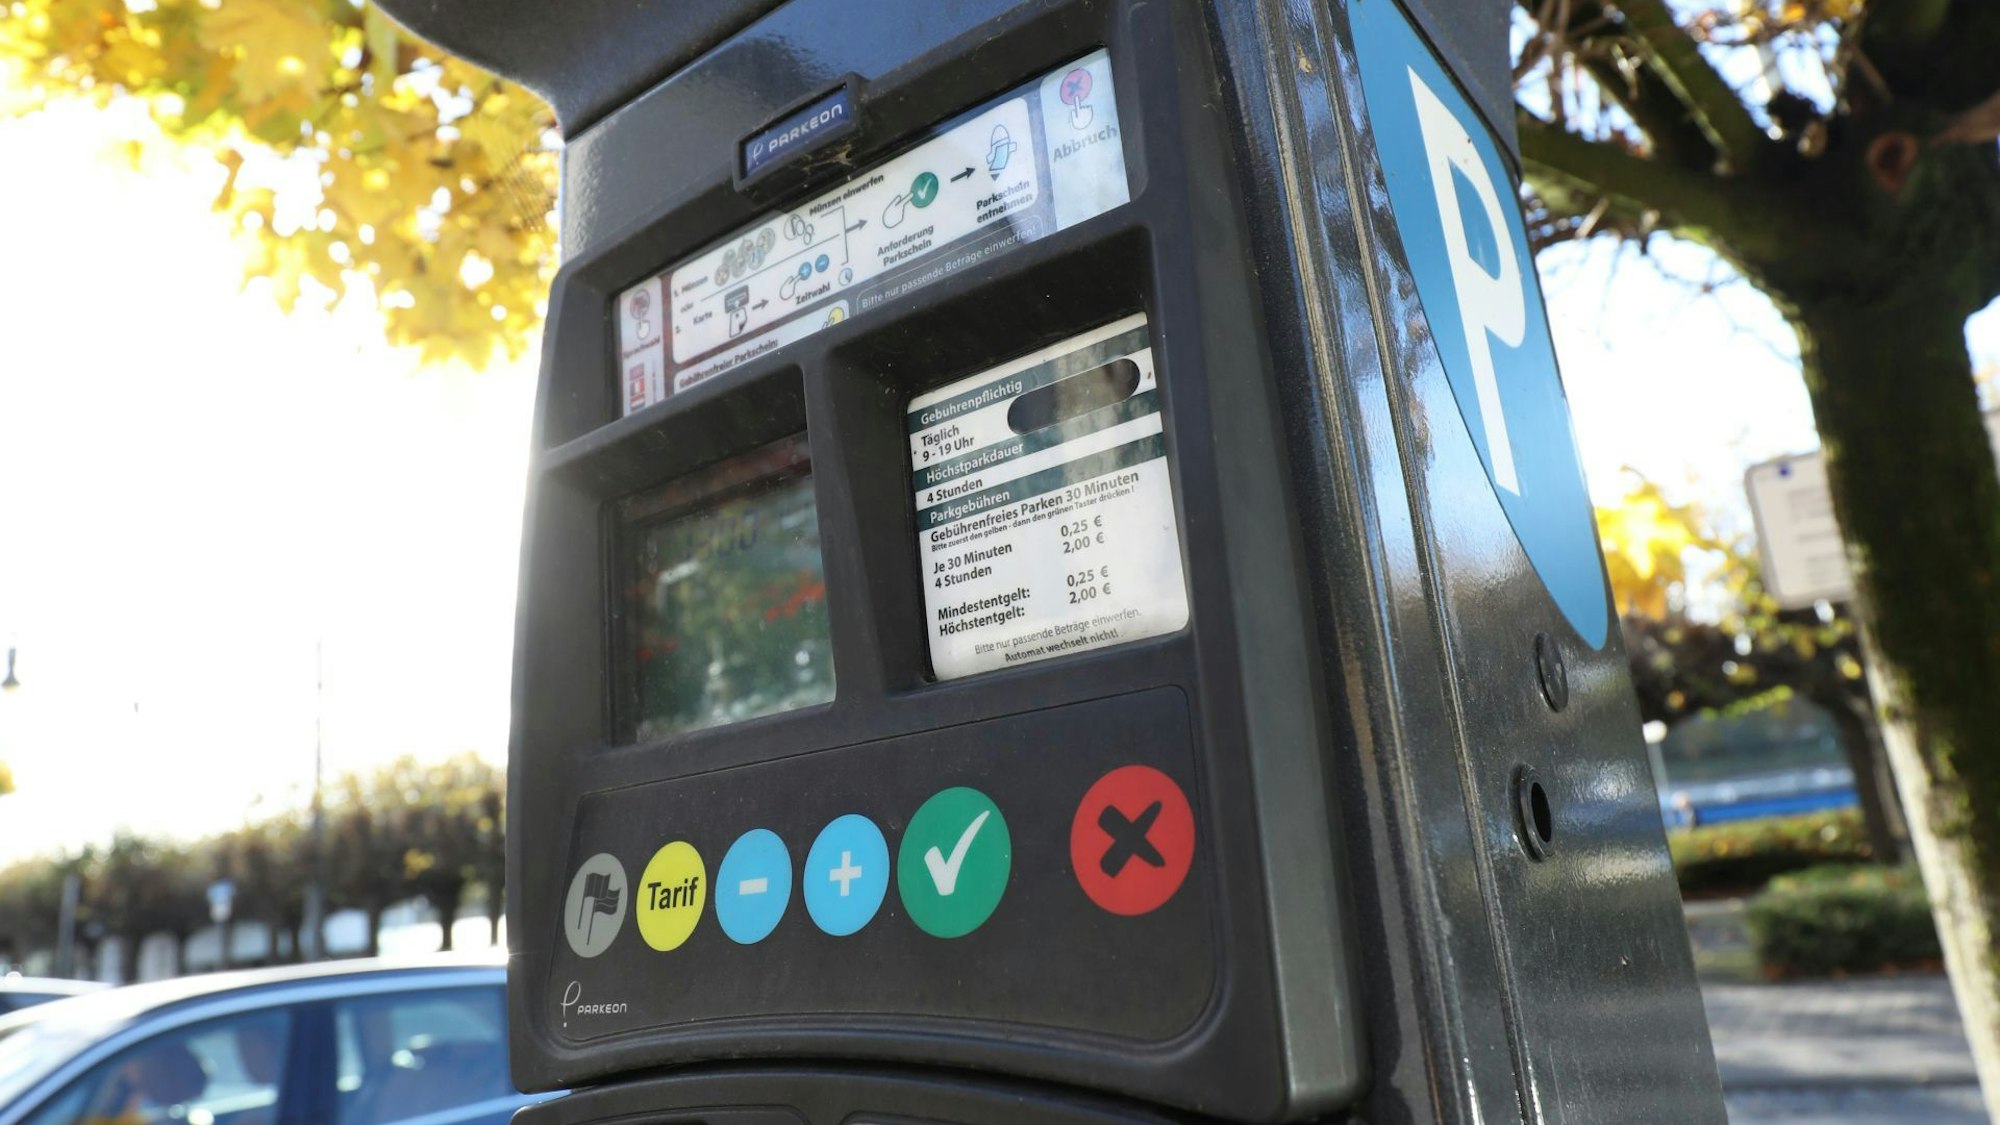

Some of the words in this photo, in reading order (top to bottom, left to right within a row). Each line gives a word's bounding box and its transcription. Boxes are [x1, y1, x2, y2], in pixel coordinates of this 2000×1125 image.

[767, 103, 843, 153] PARKEON
[1053, 124, 1118, 163] Abbruch
[842, 173, 884, 200] einwerfen
[976, 179, 1030, 211] Parkschein
[976, 193, 1033, 223] entnehmen
[878, 225, 934, 257] Anforderung
[883, 239, 932, 267] Parkschein
[862, 293, 882, 308] Bitte
[884, 287, 900, 299] nur
[901, 267, 944, 294] passende
[945, 250, 983, 273] Beträge
[984, 226, 1037, 255] einwerfen!
[1406, 64, 1526, 497] P
[795, 282, 831, 305] Zeitwahl
[693, 311, 713, 325] Karte
[734, 339, 778, 364] Parkschein:
[921, 425, 960, 447] Täglich
[922, 450, 930, 462] 9
[938, 443, 952, 457] 19
[954, 436, 974, 451] Uhr
[926, 443, 1024, 484] Höchstparkdauer
[926, 493, 934, 504] 4
[936, 477, 983, 501] Stunden
[930, 508, 1018, 542] Gebührenfreies
[1021, 494, 1063, 516] Parken
[1065, 487, 1081, 502] 30
[1084, 472, 1139, 496] Minuten
[930, 491, 1011, 524] Parkgebühren
[931, 542, 947, 552] Bitte
[948, 536, 968, 547] zuerst
[970, 531, 983, 541] den
[983, 524, 1008, 538] gelben
[1013, 518, 1031, 528] dann
[1032, 512, 1046, 522] den
[1047, 504, 1074, 519] grünen
[1075, 497, 1097, 510] Taster
[1099, 488, 1130, 502] drücken
[933, 562, 946, 575] Je
[947, 556, 961, 570] 30
[964, 543, 1013, 565] Minuten
[1060, 519, 1088, 537] 0,25
[1093, 514, 1103, 527] €
[935, 578, 942, 589] 4
[944, 564, 992, 588] Stunden
[1062, 535, 1091, 554] 2,00
[1096, 531, 1105, 544] €
[937, 586, 1031, 622] Mindestentgelt:
[1066, 566, 1095, 587] 0,25
[1100, 565, 1109, 579] €
[938, 606, 1025, 637] Höchstentgelt:
[1069, 586, 1097, 605] 2,00
[1102, 582, 1112, 595] €
[974, 640, 995, 655] Bitte
[996, 639, 1010, 649] nur
[1012, 627, 1054, 649] passende
[1054, 620, 1091, 637] Beträge
[1091, 608, 1142, 627] einwerfen.
[1004, 645, 1045, 662] Automat
[1045, 635, 1089, 652] wechselt
[1089, 628, 1119, 644] nicht!
[647, 877, 699, 910] Tarif
[577, 1003, 628, 1014] PARKEON
